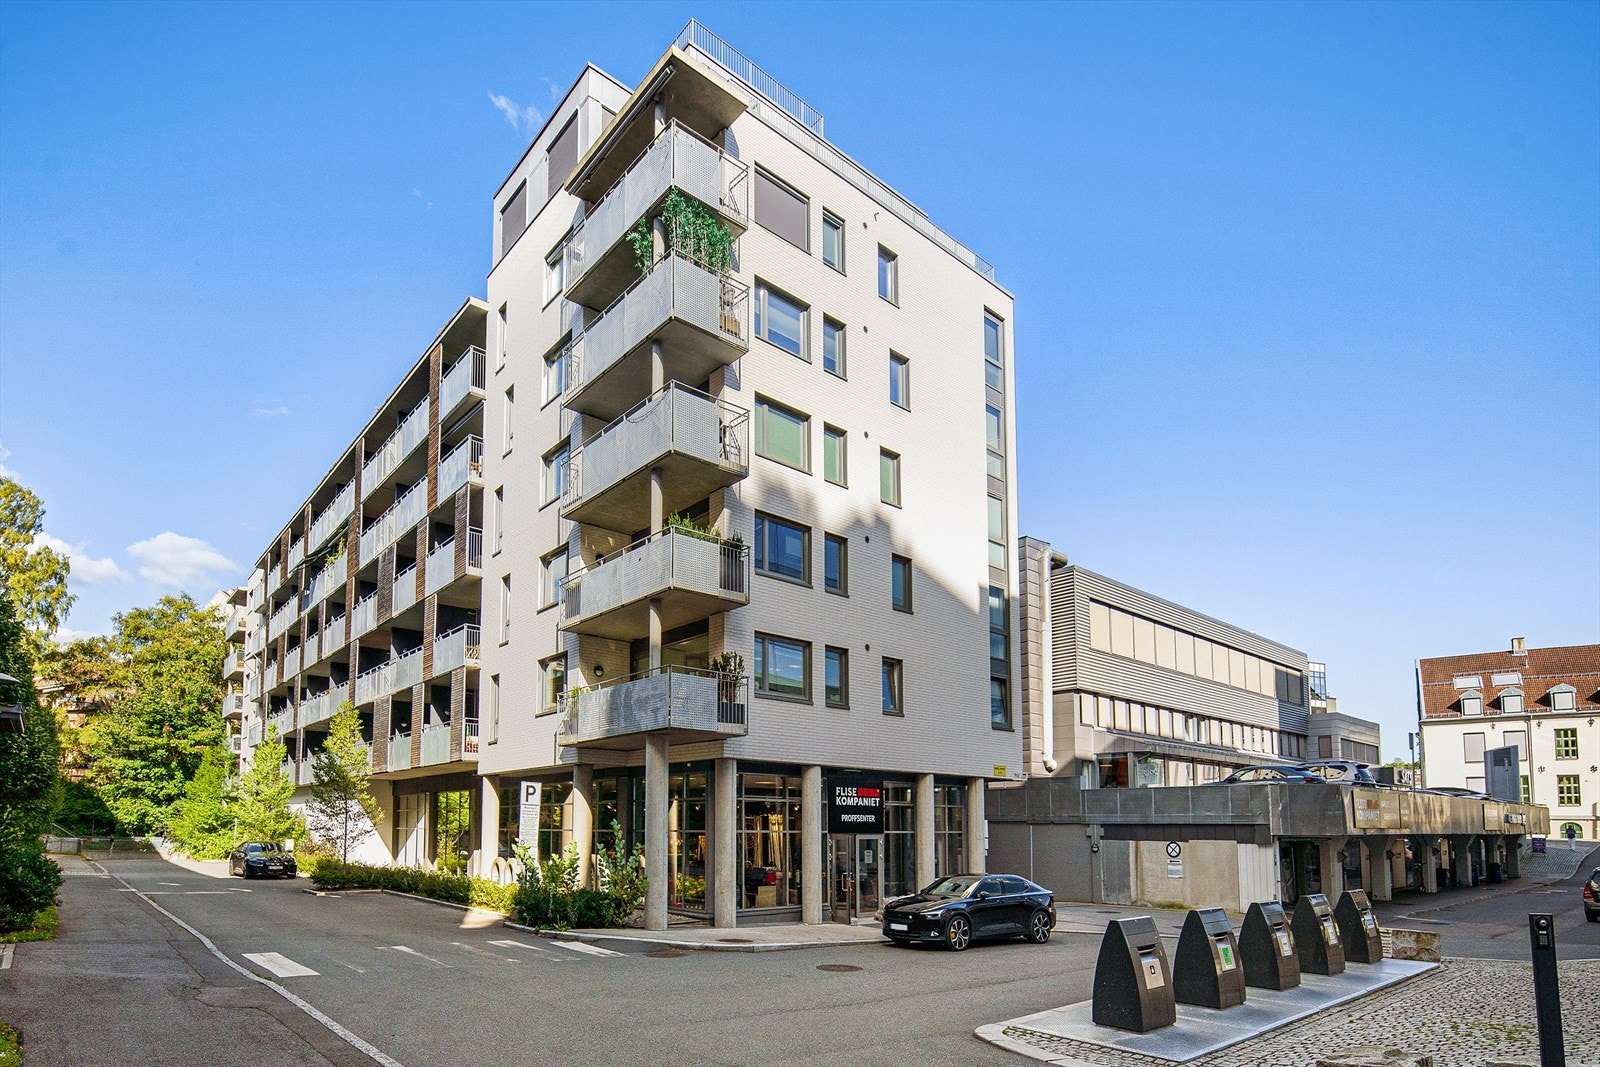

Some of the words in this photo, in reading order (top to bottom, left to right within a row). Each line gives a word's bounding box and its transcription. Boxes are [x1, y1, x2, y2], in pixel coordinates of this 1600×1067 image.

[525, 785, 536, 802] P
[835, 786, 857, 797] FLISE
[835, 796, 880, 807] KOMPANIET
[841, 814, 875, 822] PROFFSENTER
